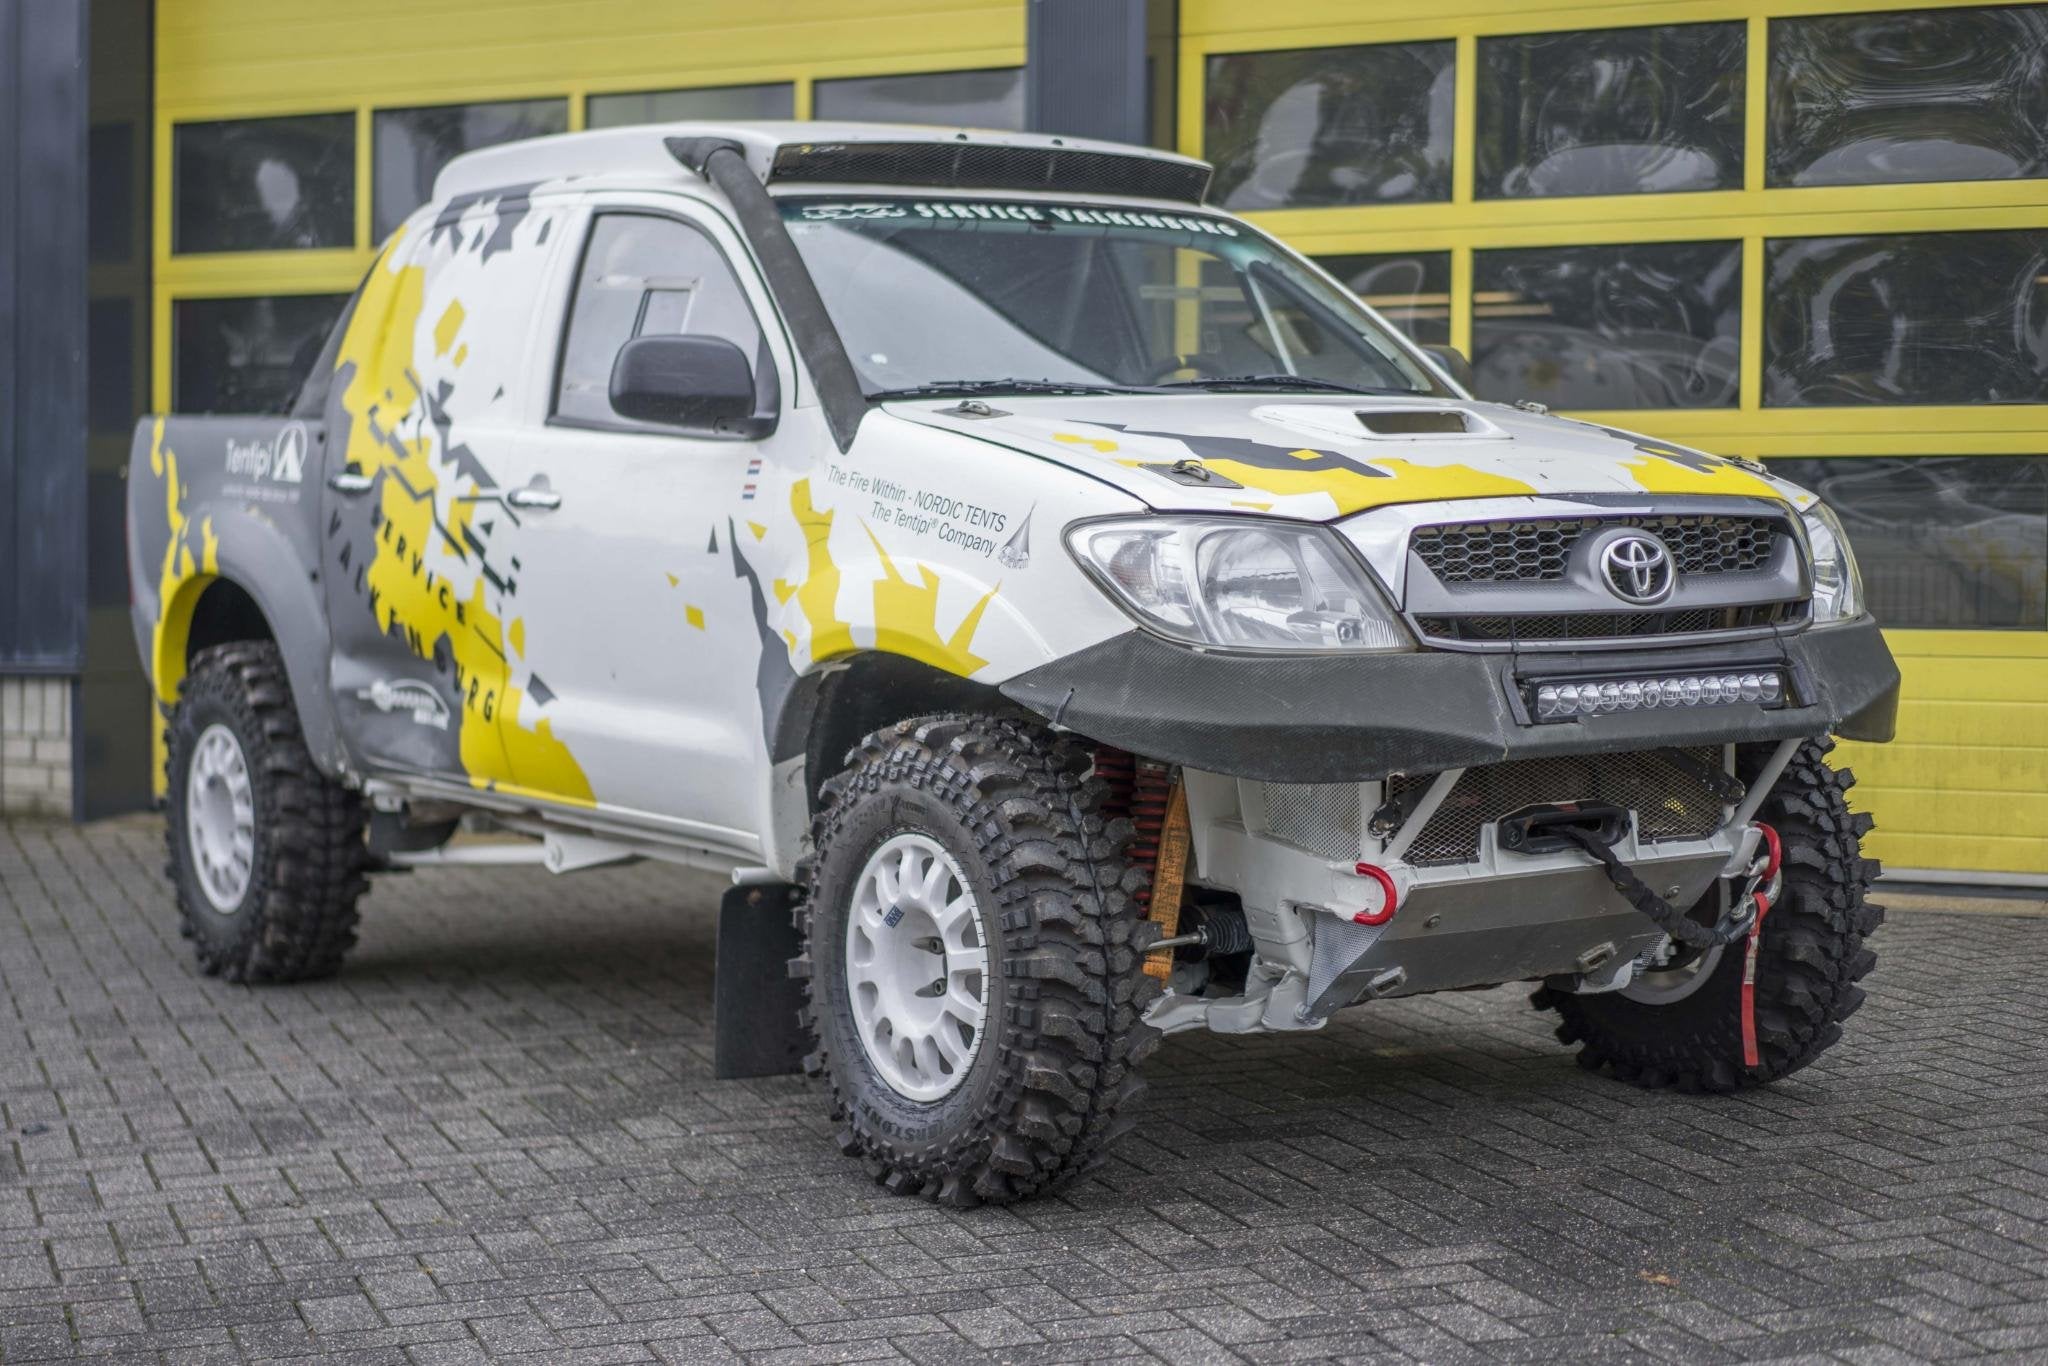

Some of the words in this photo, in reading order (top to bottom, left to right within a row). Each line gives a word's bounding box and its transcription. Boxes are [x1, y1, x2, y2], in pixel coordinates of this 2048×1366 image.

[914, 202, 1044, 221] SERVICE
[1049, 206, 1239, 237] VALKENBURG
[827, 464, 847, 486] The
[849, 471, 869, 492] Fire
[872, 477, 905, 503] Within
[914, 490, 963, 520] NORDIC
[965, 503, 1007, 533] TENTS
[872, 501, 891, 523] The
[938, 522, 998, 558] Company
[370, 502, 467, 627] SERVICE
[1582, 691, 1643, 706] VISION
